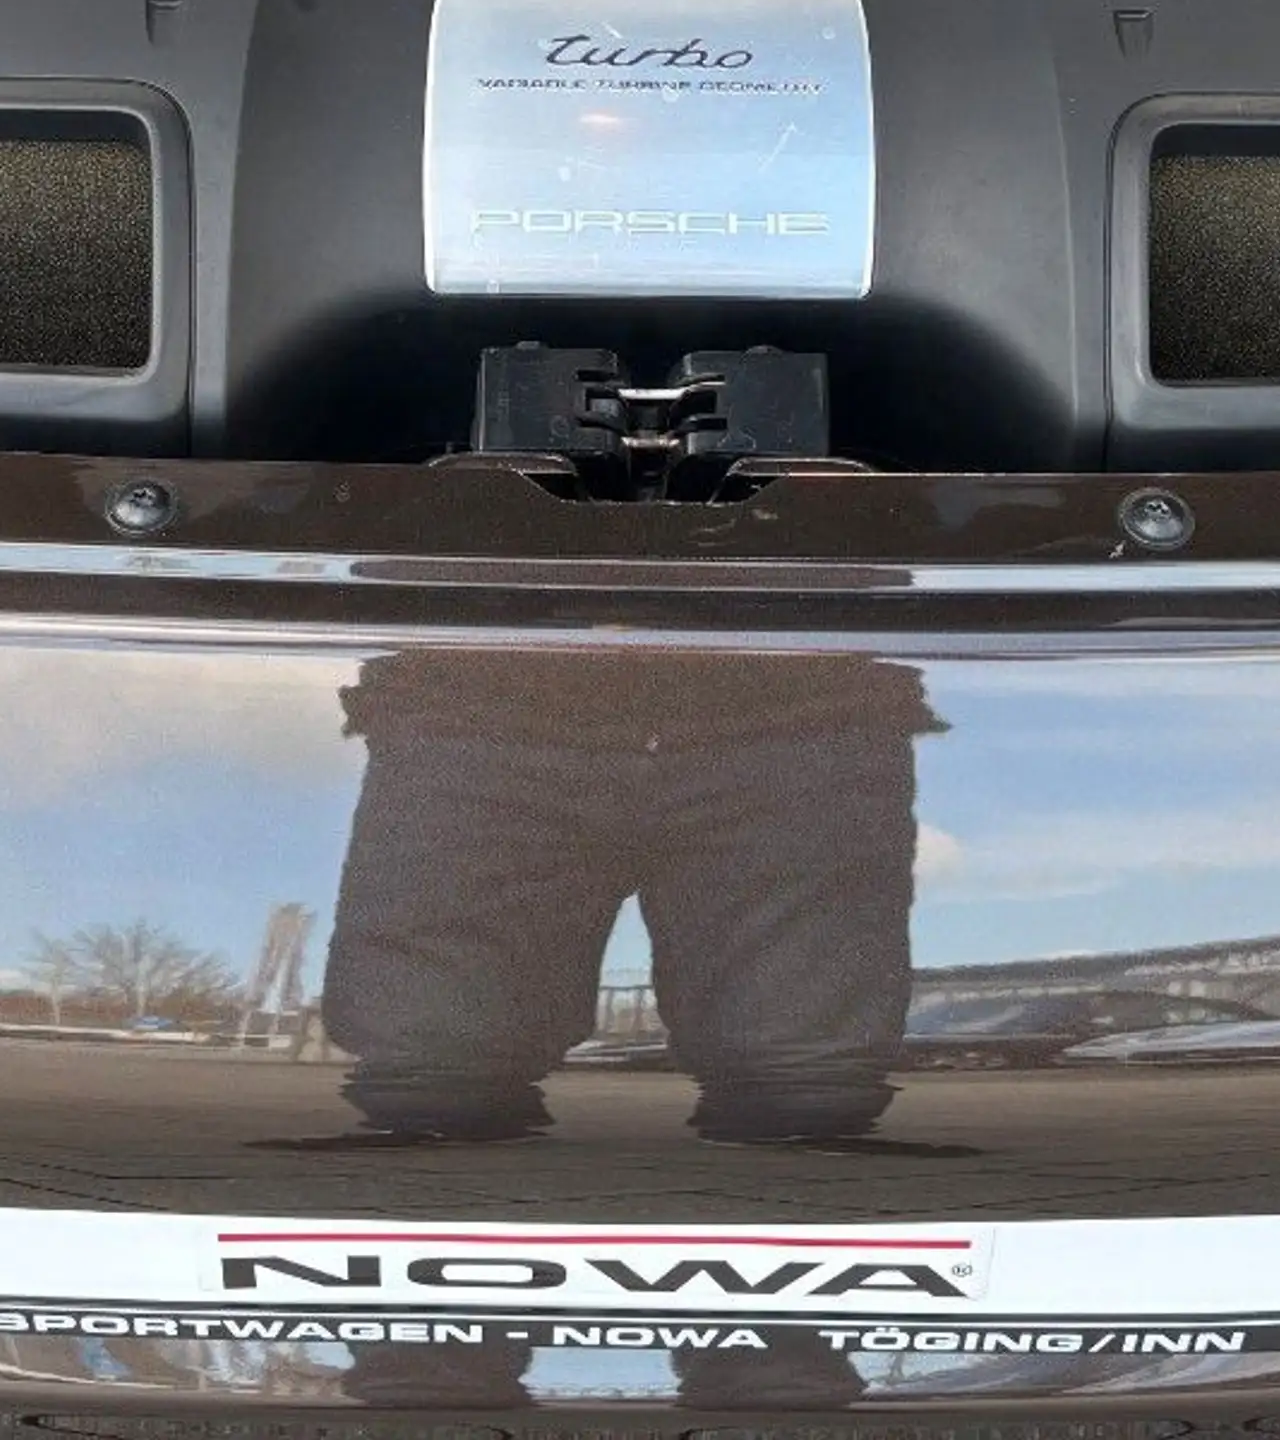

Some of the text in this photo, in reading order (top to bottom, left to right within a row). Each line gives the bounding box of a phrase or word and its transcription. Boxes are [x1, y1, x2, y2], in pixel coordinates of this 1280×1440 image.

[546, 34, 753, 68] turbo
[472, 208, 831, 237] PORSCHE
[220, 1255, 969, 1297] NOWA
[552, 1324, 769, 1349] NOWA
[818, 1326, 1246, 1353] TÖGING/INN
